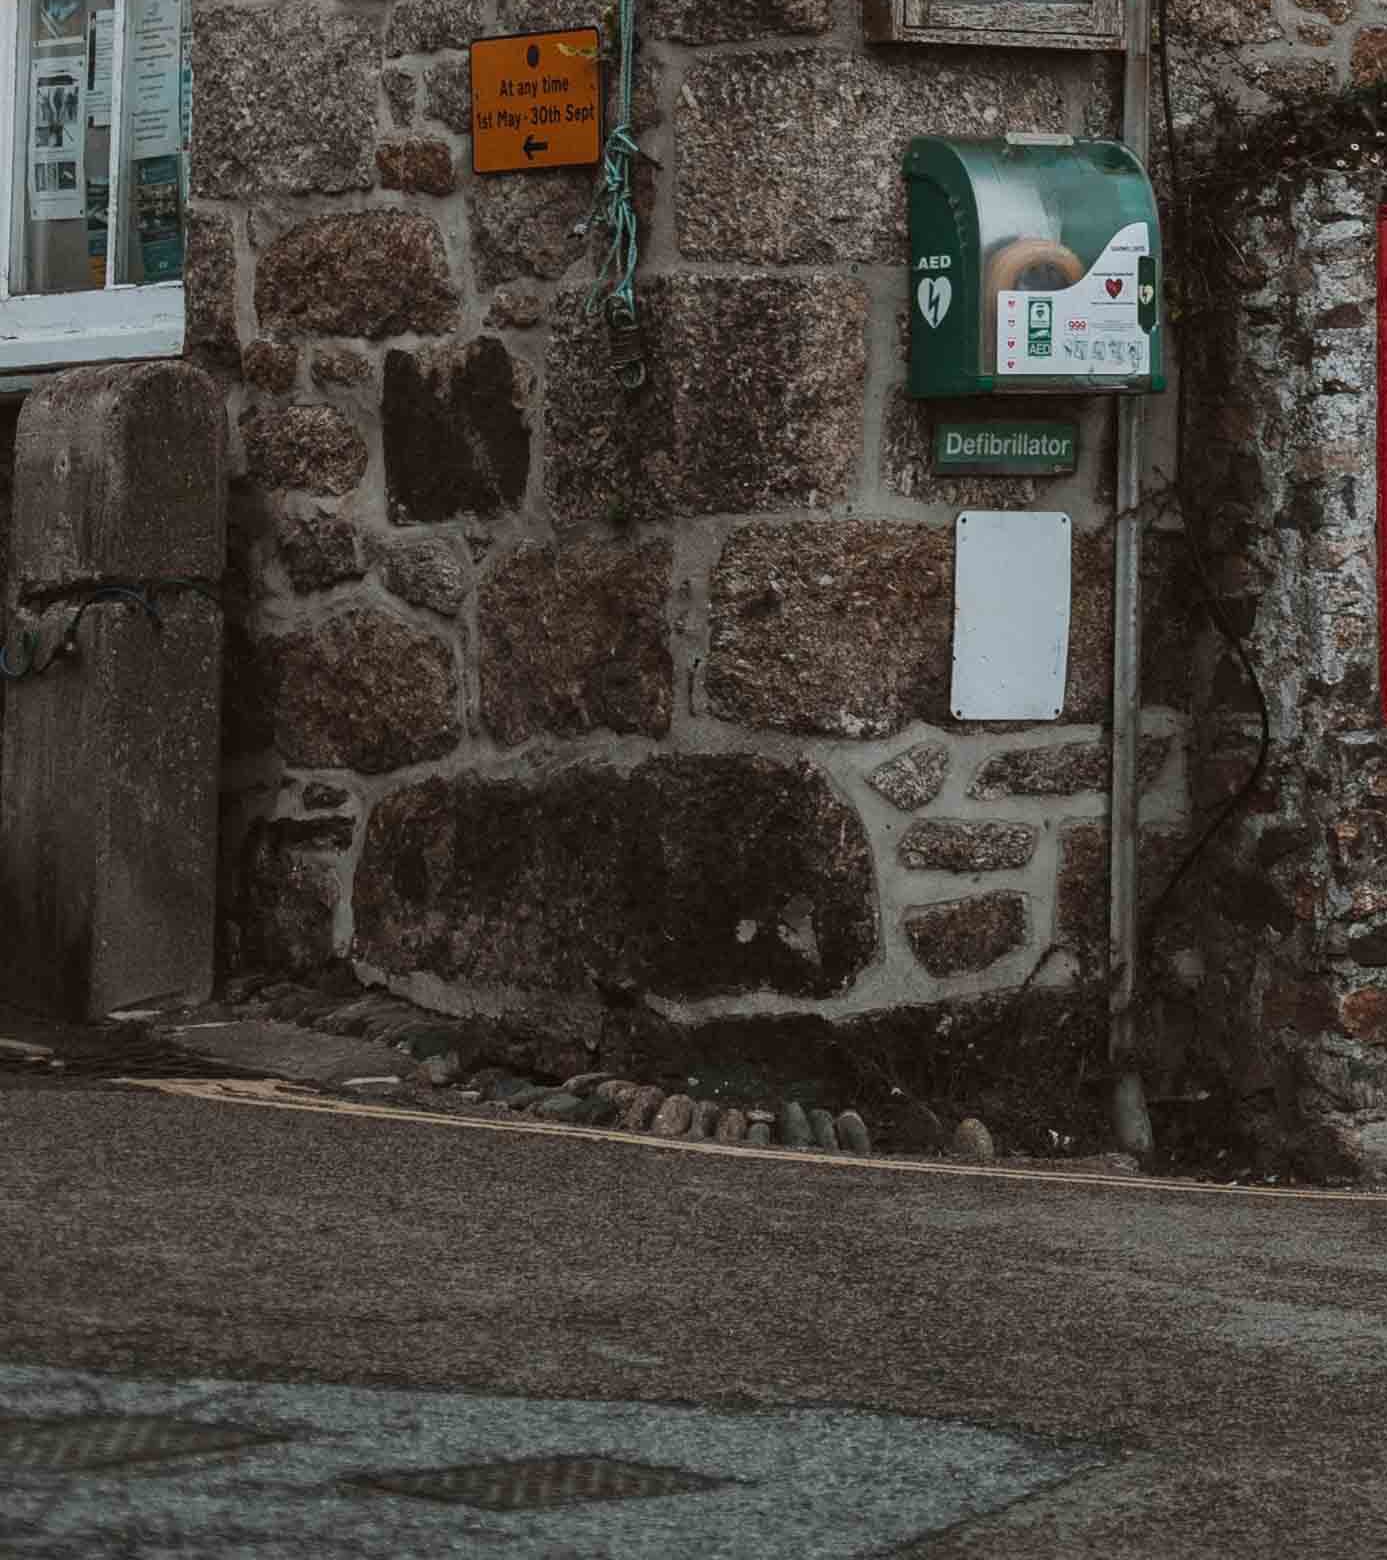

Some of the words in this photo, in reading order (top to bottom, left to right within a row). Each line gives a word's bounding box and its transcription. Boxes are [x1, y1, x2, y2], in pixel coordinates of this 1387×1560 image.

[499, 79, 515, 98] At
[516, 80, 538, 99] any
[541, 75, 570, 93] time
[477, 113, 493, 130] 1st
[496, 109, 522, 131] May
[530, 106, 562, 126] 30th
[564, 103, 596, 126] Sept
[918, 255, 952, 270] AED
[946, 431, 1071, 457] Defibrillator
